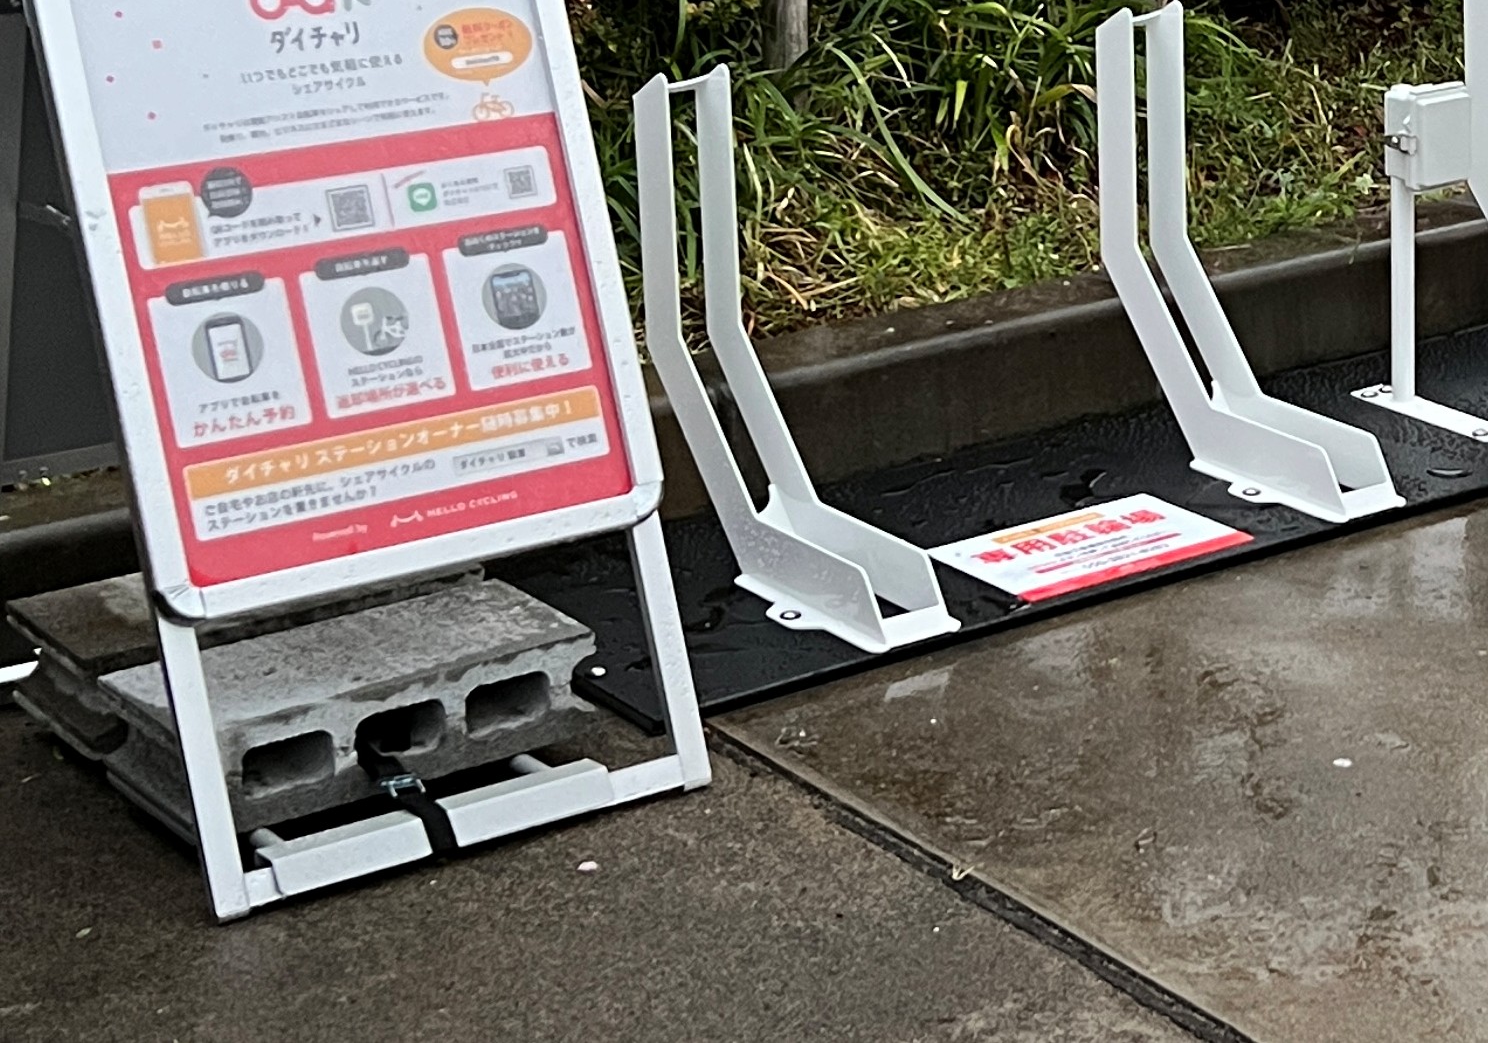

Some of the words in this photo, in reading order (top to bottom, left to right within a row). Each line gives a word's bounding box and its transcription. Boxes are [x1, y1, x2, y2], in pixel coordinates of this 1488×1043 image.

[270, 21, 360, 54] ダイチャリ
[240, 54, 404, 84] いつでもどこでも気軽に使える
[292, 76, 367, 95] シェアサイクル
[491, 353, 570, 380] 便利に使える
[199, 390, 281, 414] アプリで自転車を
[193, 405, 296, 438] かんたん予約
[225, 453, 310, 485] ダイチャリ
[426, 501, 467, 519] HELLO
[468, 490, 519, 509] CYCLING
[970, 509, 1166, 564] 専用駐輪場
